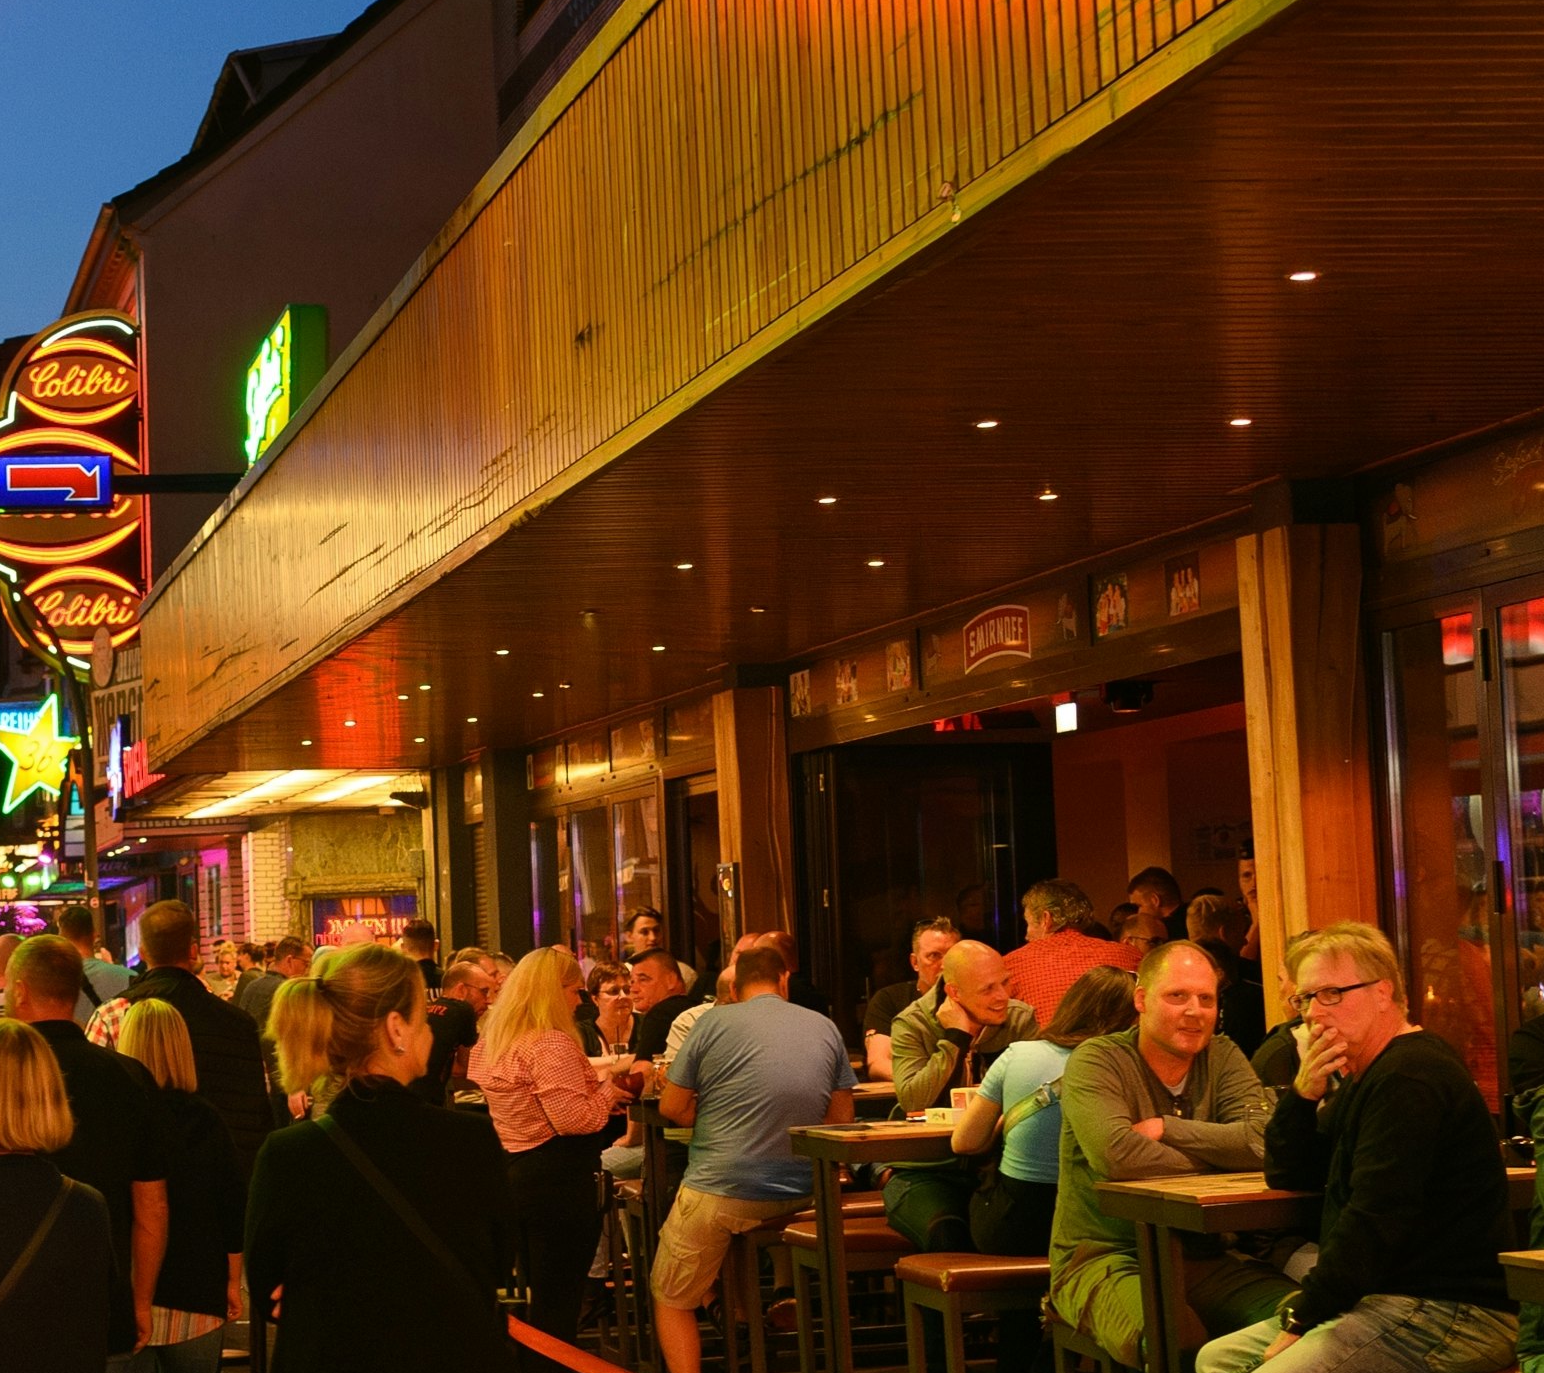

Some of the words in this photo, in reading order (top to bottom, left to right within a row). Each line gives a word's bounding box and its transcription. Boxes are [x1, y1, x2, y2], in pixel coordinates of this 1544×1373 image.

[29, 361, 129, 398] Colibri
[969, 615, 1024, 658] SMIRNOFF
[20, 741, 52, 773] 36
